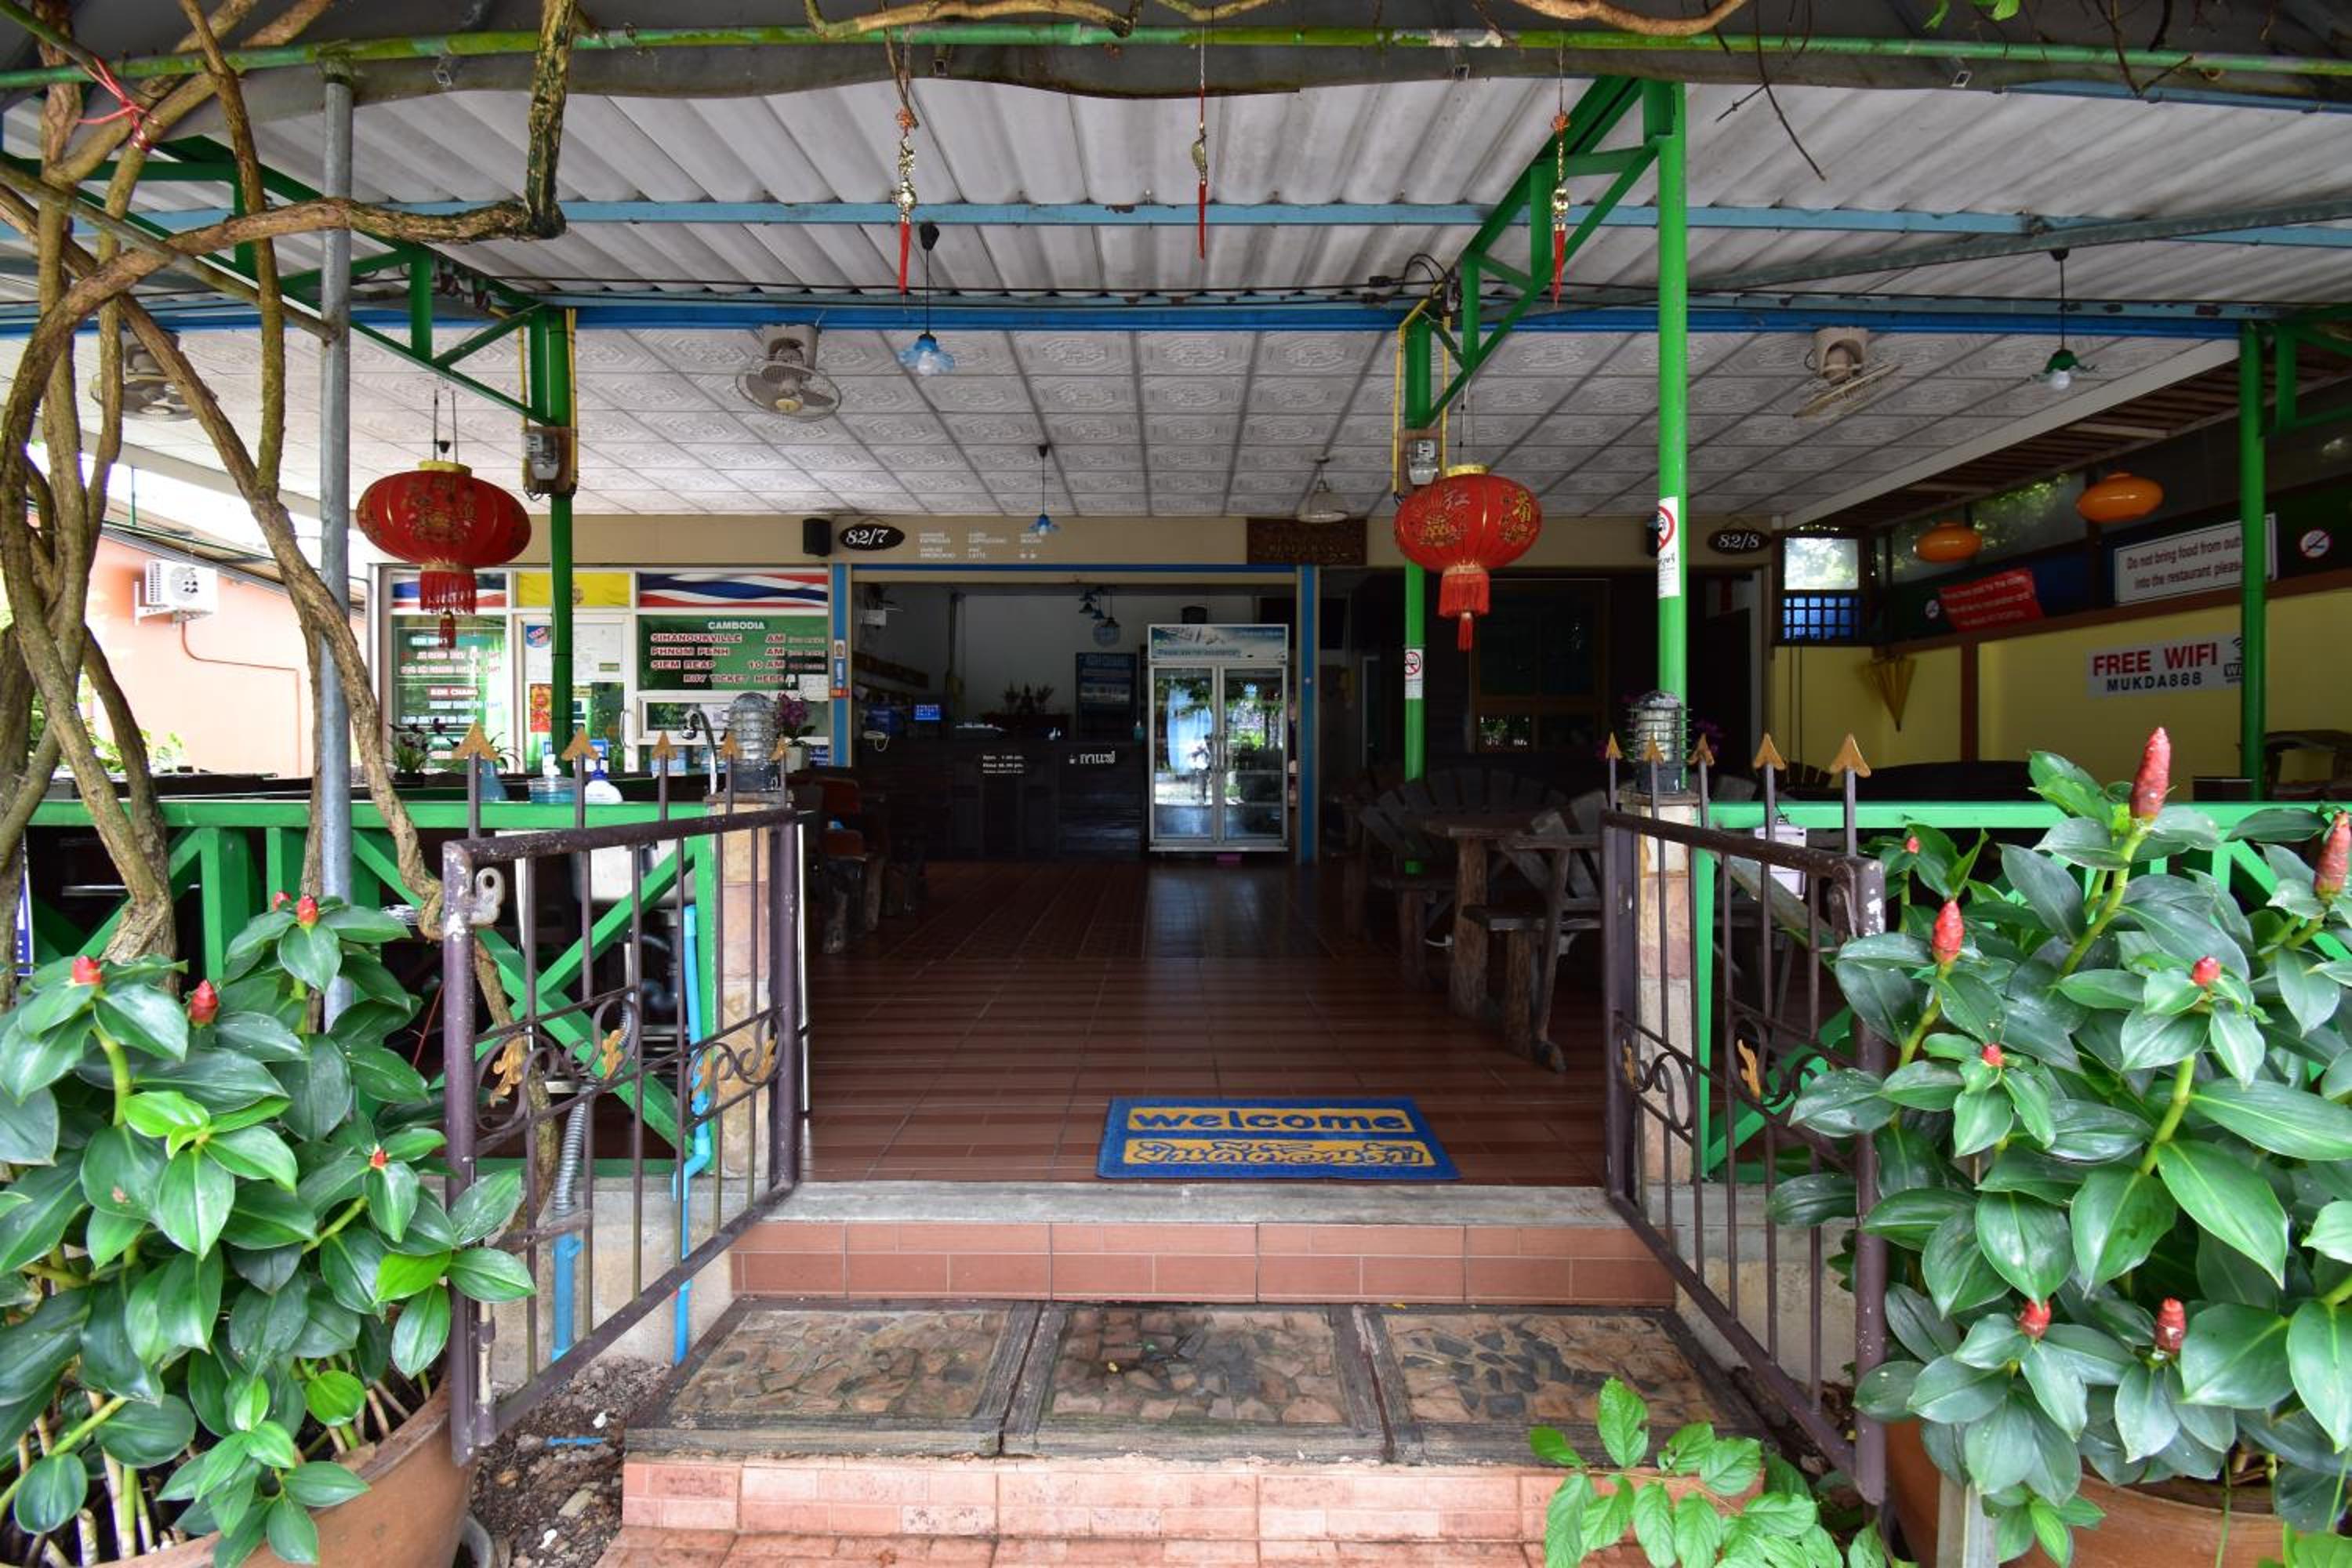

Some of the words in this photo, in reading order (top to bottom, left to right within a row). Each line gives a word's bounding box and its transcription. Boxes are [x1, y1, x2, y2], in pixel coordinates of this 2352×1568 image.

[845, 528, 889, 546] 82/7
[1718, 532, 1760, 550] 82/8
[2126, 557, 2139, 570] Do
[2140, 554, 2153, 567] not
[2154, 549, 2177, 564] bring
[2177, 542, 2198, 559] food
[2200, 540, 2222, 554] from
[2223, 536, 2242, 550] out
[2134, 576, 2151, 590] into
[2152, 574, 2165, 586] the
[2166, 564, 2212, 583] restaurant
[707, 621, 766, 630] CAMBODIA
[650, 633, 742, 644] SIHANOUKVILLE
[765, 632, 786, 643] AM
[650, 646, 695, 656] PHNOM
[696, 646, 731, 656] PENH
[764, 646, 786, 657] AM
[2092, 650, 2152, 677] FREE
[2164, 642, 2218, 670] WIFI
[650, 659, 681, 670] SIEM
[682, 659, 717, 670] REAP
[765, 659, 786, 670] AM
[710, 673, 749, 684] TICKET
[2106, 671, 2203, 692] MUKDA888
[1132, 1110, 1406, 1130] welcome
[1137, 1140, 1425, 1166] ยินดีต้อนรับ
